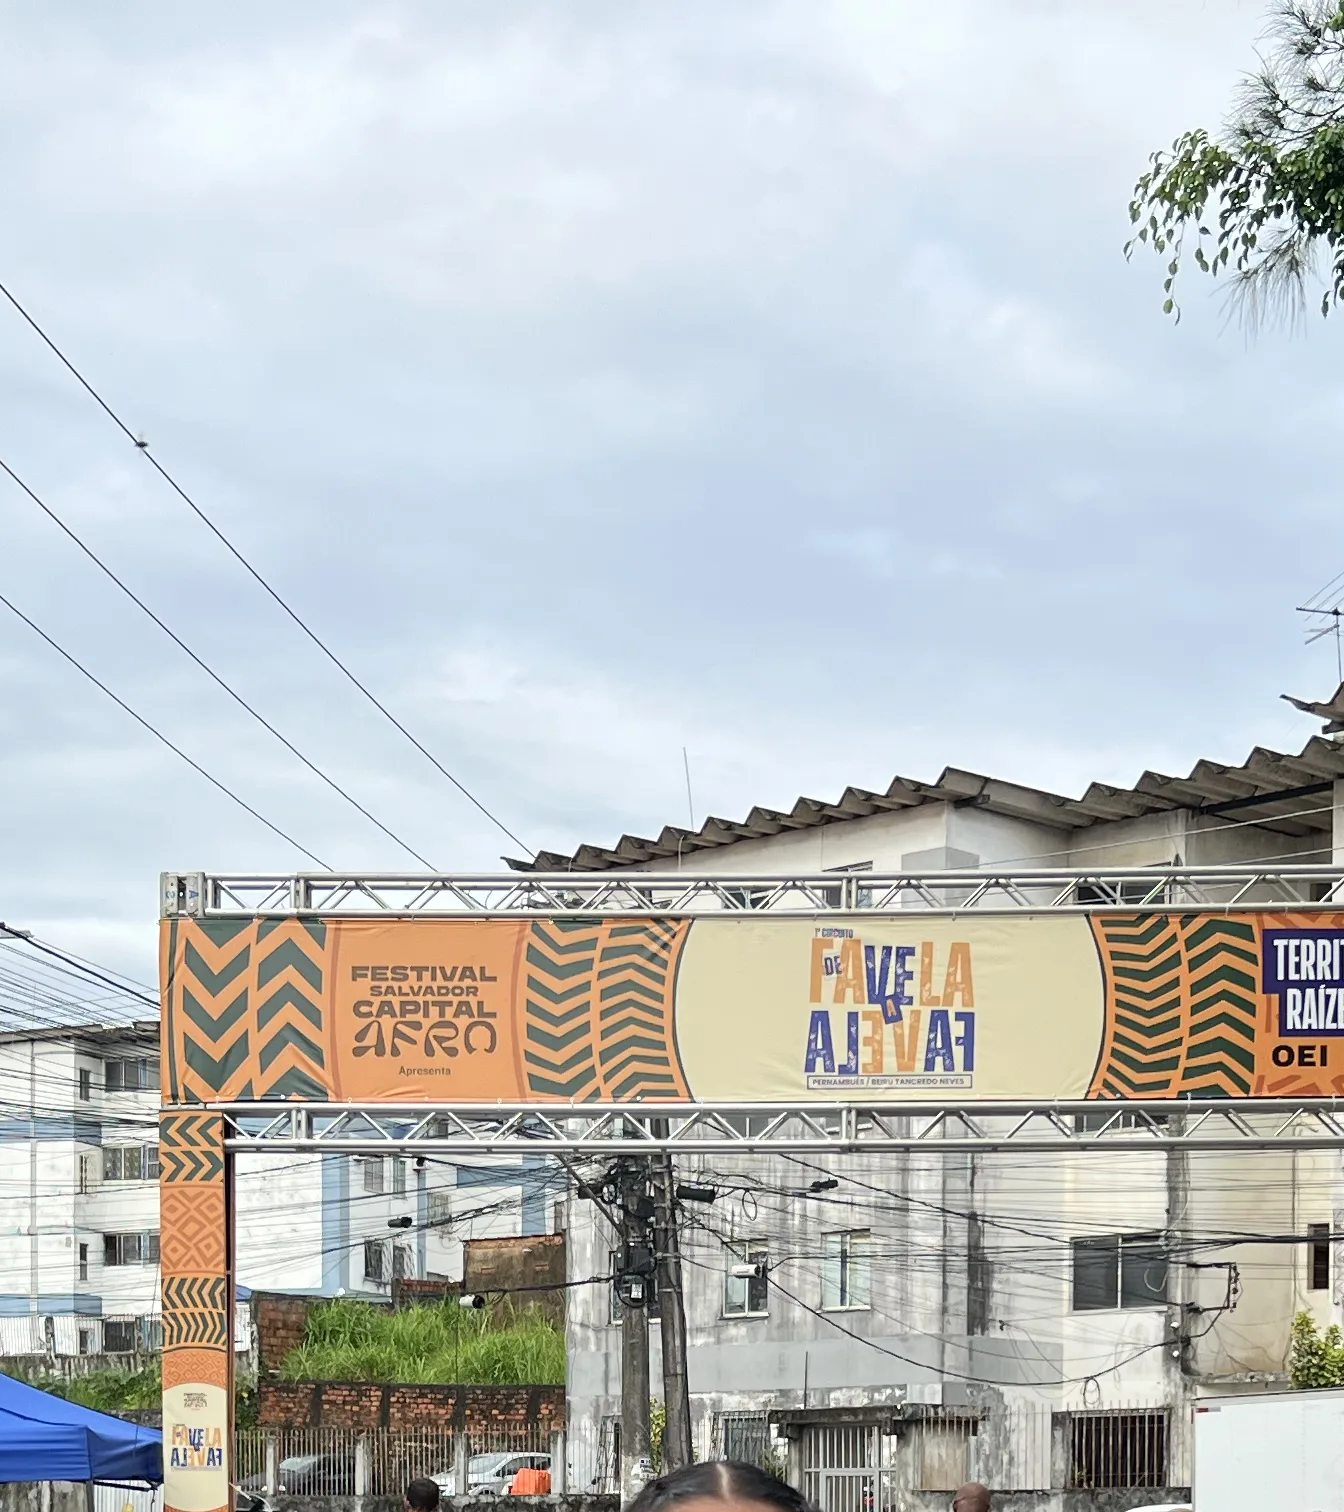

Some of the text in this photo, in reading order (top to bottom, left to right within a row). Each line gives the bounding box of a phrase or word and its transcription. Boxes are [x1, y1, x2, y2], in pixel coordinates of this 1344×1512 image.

[351, 966, 498, 983] FESTIVAL
[810, 938, 974, 1007] FAVELA
[369, 985, 479, 997] SALVADOR
[352, 1000, 497, 1019] CAPITAL
[352, 1020, 497, 1058] AFRO
[1272, 1044, 1328, 1067] OEI
[398, 1066, 452, 1077] Apresenta
